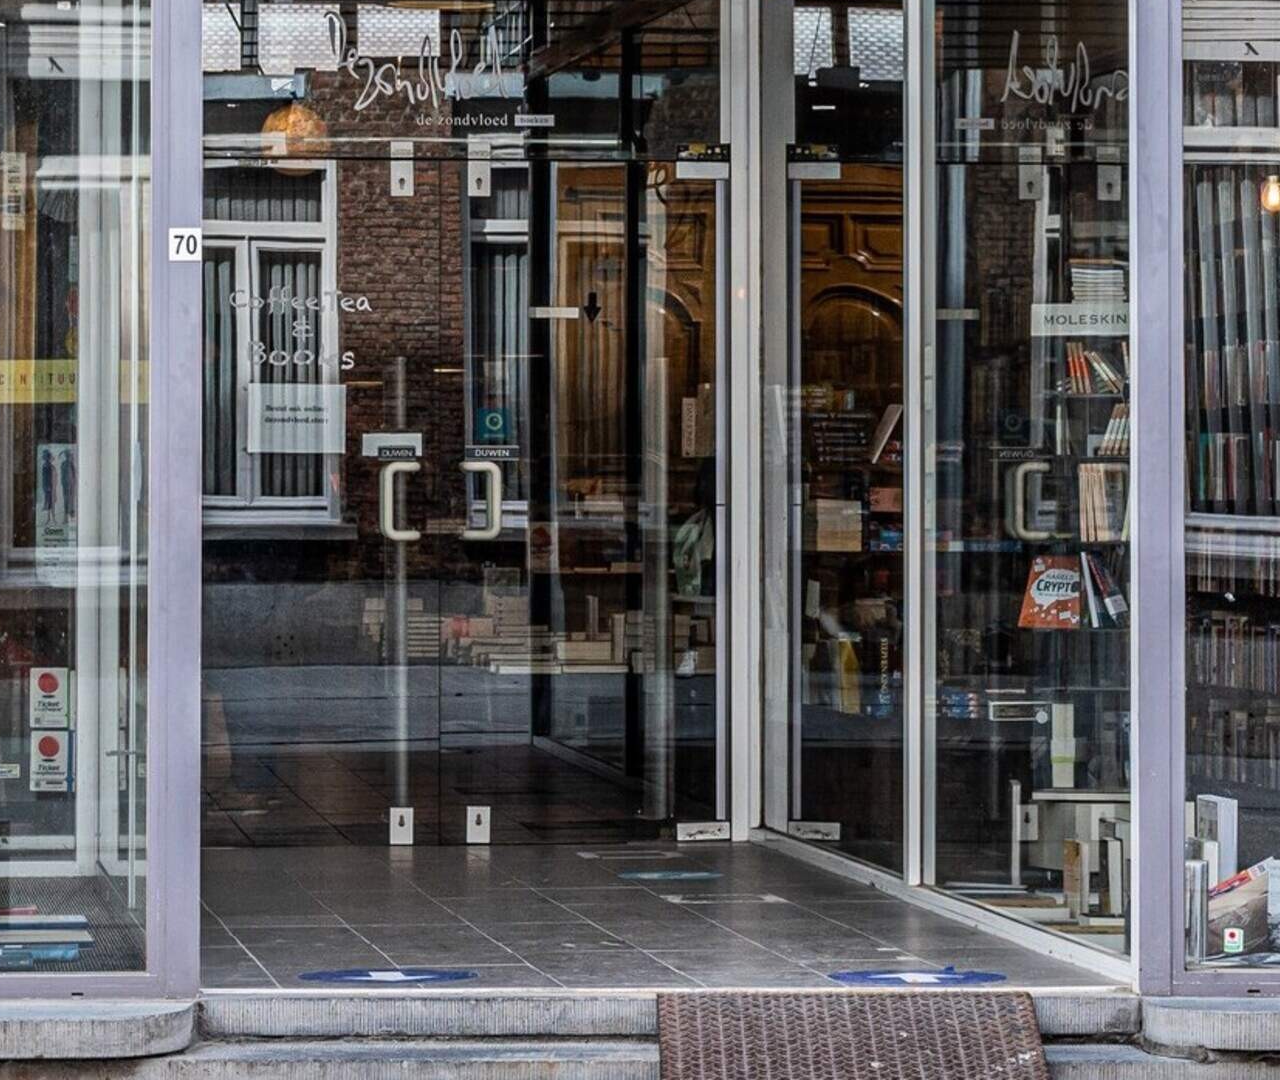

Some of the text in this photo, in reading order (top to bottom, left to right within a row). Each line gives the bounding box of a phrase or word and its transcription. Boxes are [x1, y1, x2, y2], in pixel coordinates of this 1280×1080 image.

[173, 234, 198, 255] 70
[1044, 314, 1128, 326] MOLESKIN
[475, 449, 509, 457] DUWEN
